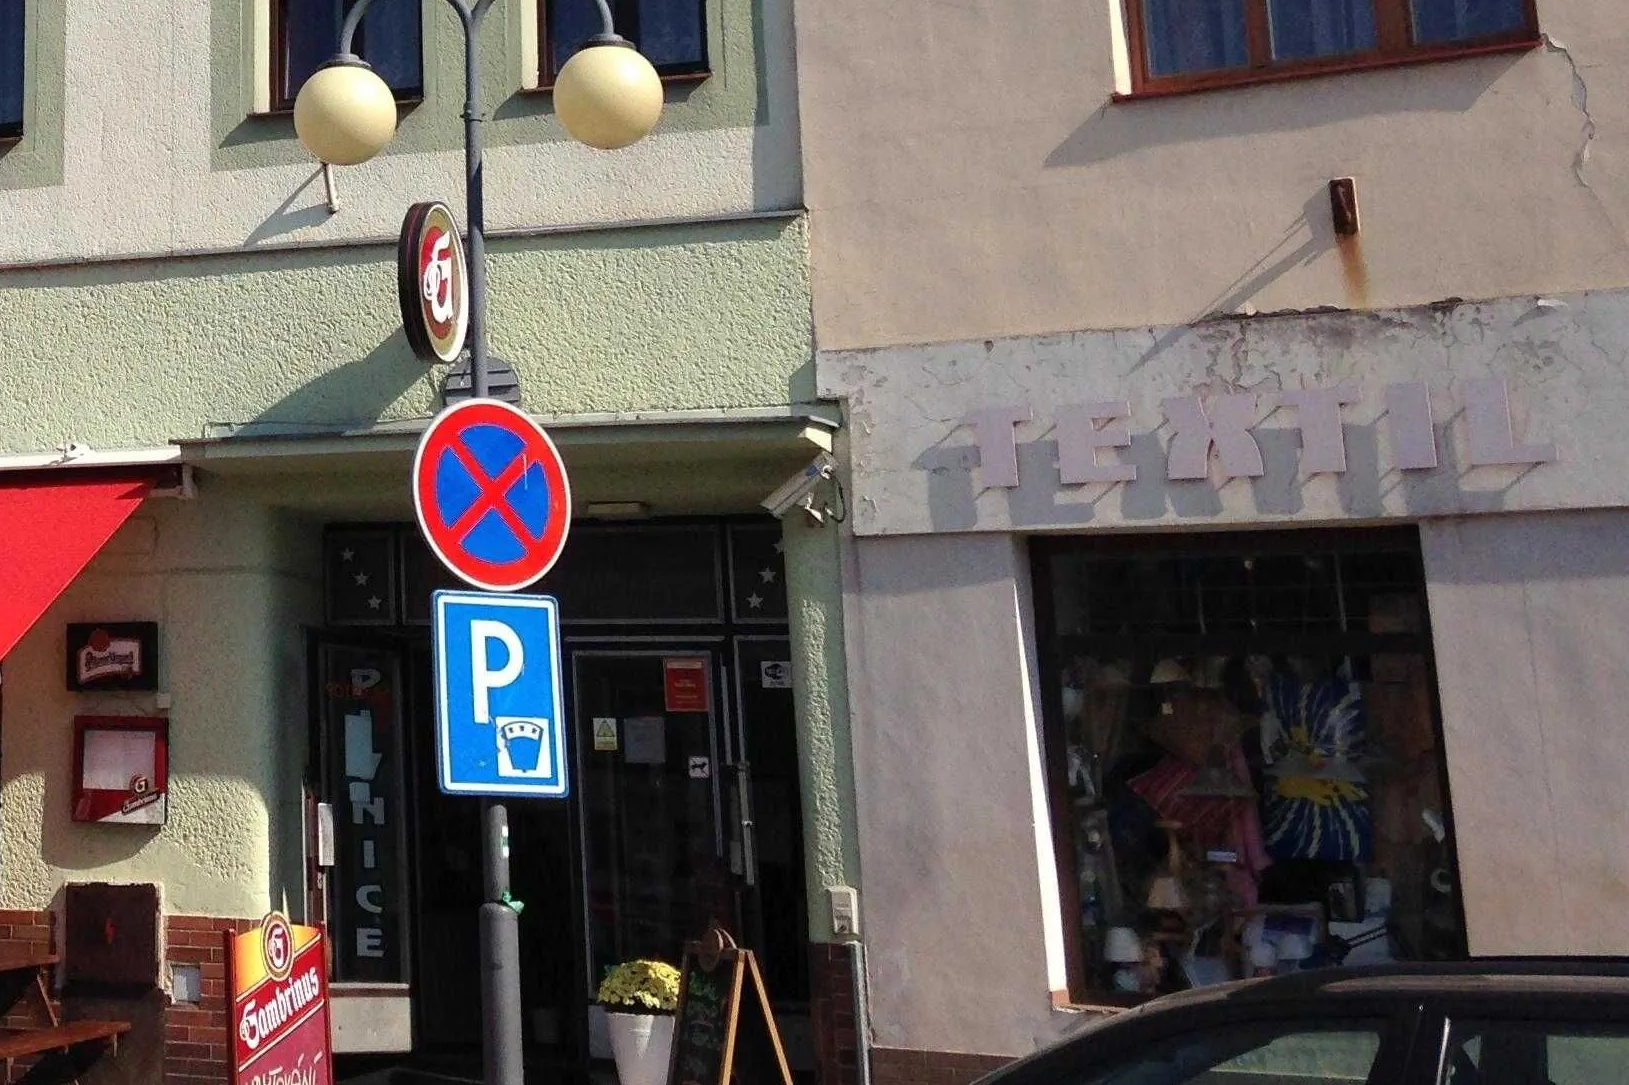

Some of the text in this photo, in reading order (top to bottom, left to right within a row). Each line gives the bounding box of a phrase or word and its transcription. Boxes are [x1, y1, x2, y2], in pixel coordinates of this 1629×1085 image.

[968, 378, 1559, 489] TEXTIL
[470, 619, 524, 724] P
[349, 669, 386, 958] PNICE
[239, 967, 319, 1049] Gambrinus
